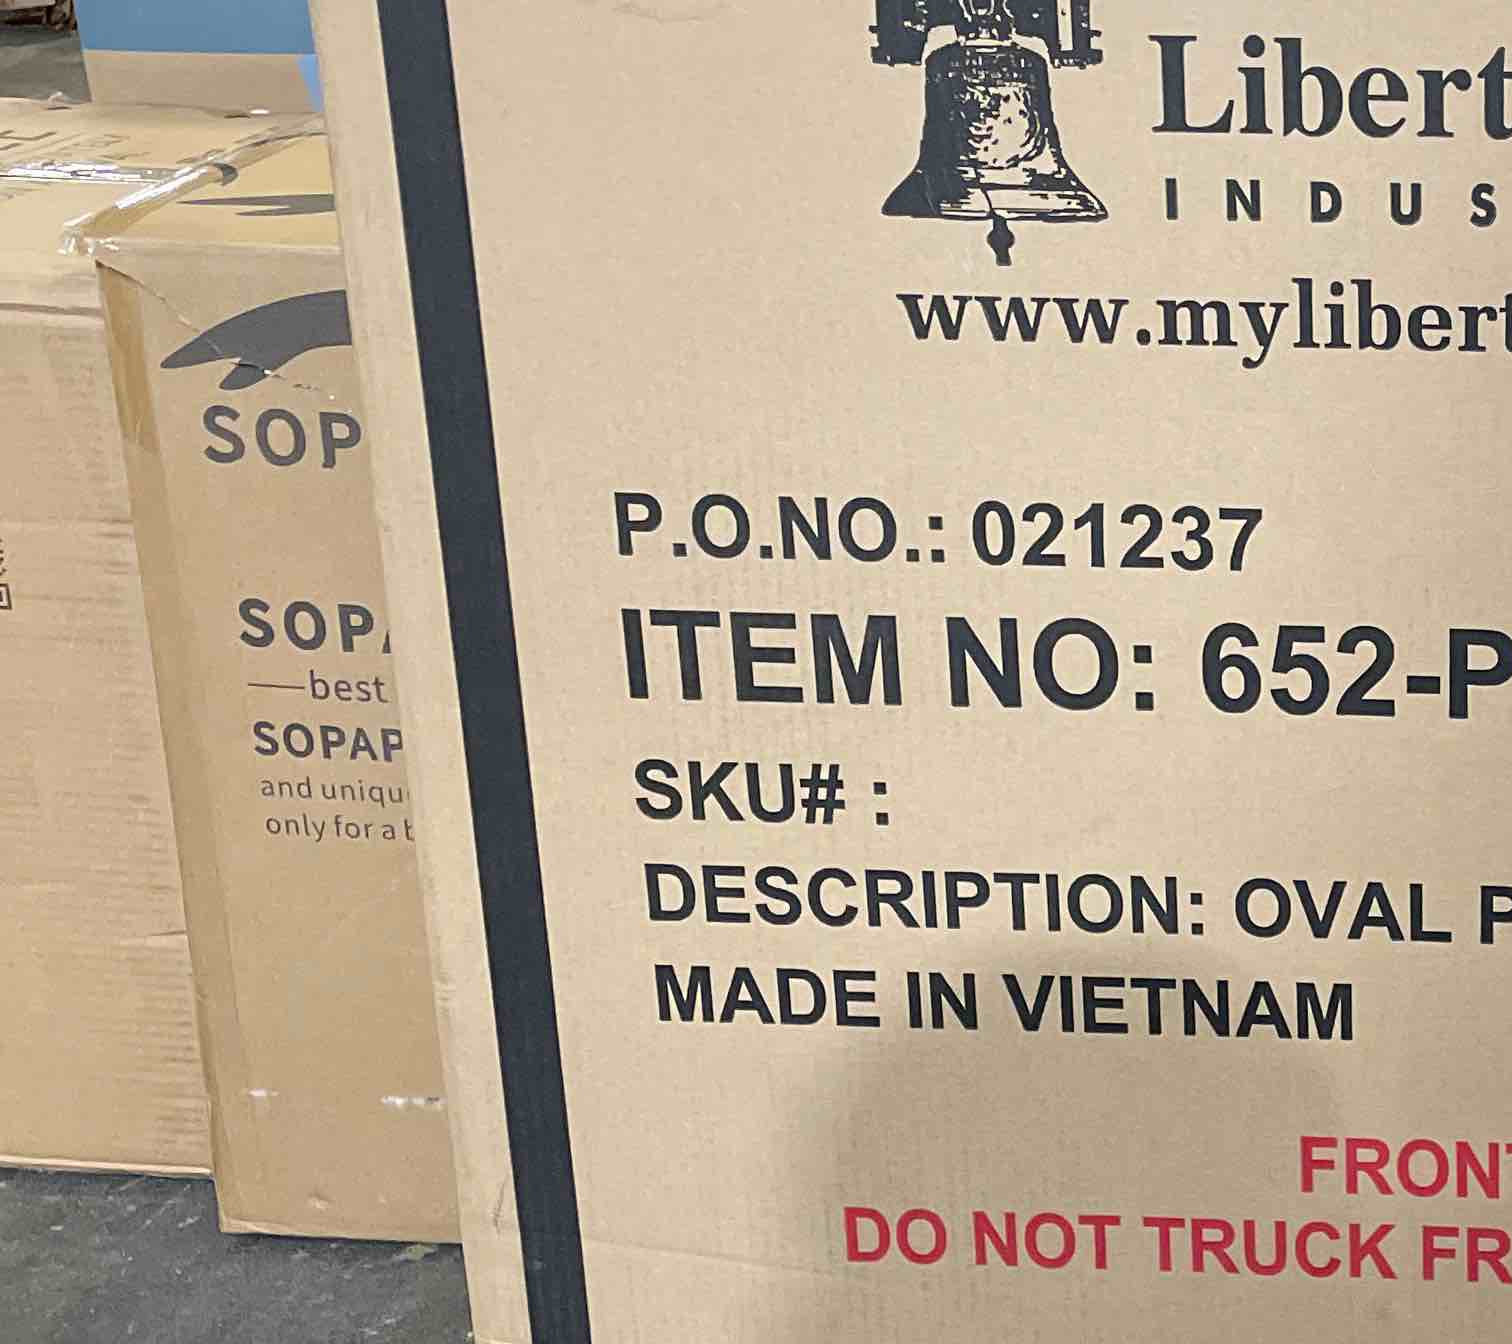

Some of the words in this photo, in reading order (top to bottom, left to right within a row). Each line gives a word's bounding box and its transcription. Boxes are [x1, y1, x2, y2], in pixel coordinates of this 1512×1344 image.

[203, 404, 362, 469] SOP
[613, 491, 946, 563] P.O.NO.:
[971, 499, 1264, 572] 021237
[309, 669, 389, 703] best
[620, 607, 903, 707] ITEM
[944, 615, 1154, 713] NO:
[253, 720, 404, 763] SOPAP
[261, 776, 312, 799] and
[321, 779, 410, 809] uniqu
[632, 757, 847, 826] SKU#
[266, 813, 326, 843] only
[334, 814, 374, 839] for
[382, 823, 397, 840] a
[643, 861, 1205, 938] DESCRIPTION:
[1233, 876, 1453, 945] OVAL
[652, 962, 881, 1029] MADE
[905, 970, 979, 1031] IN
[1001, 972, 1354, 1042] VIETNAM
[843, 1205, 948, 1266] DO
[971, 1209, 1122, 1271] NOT
[1142, 1214, 1398, 1281] TRUCK
